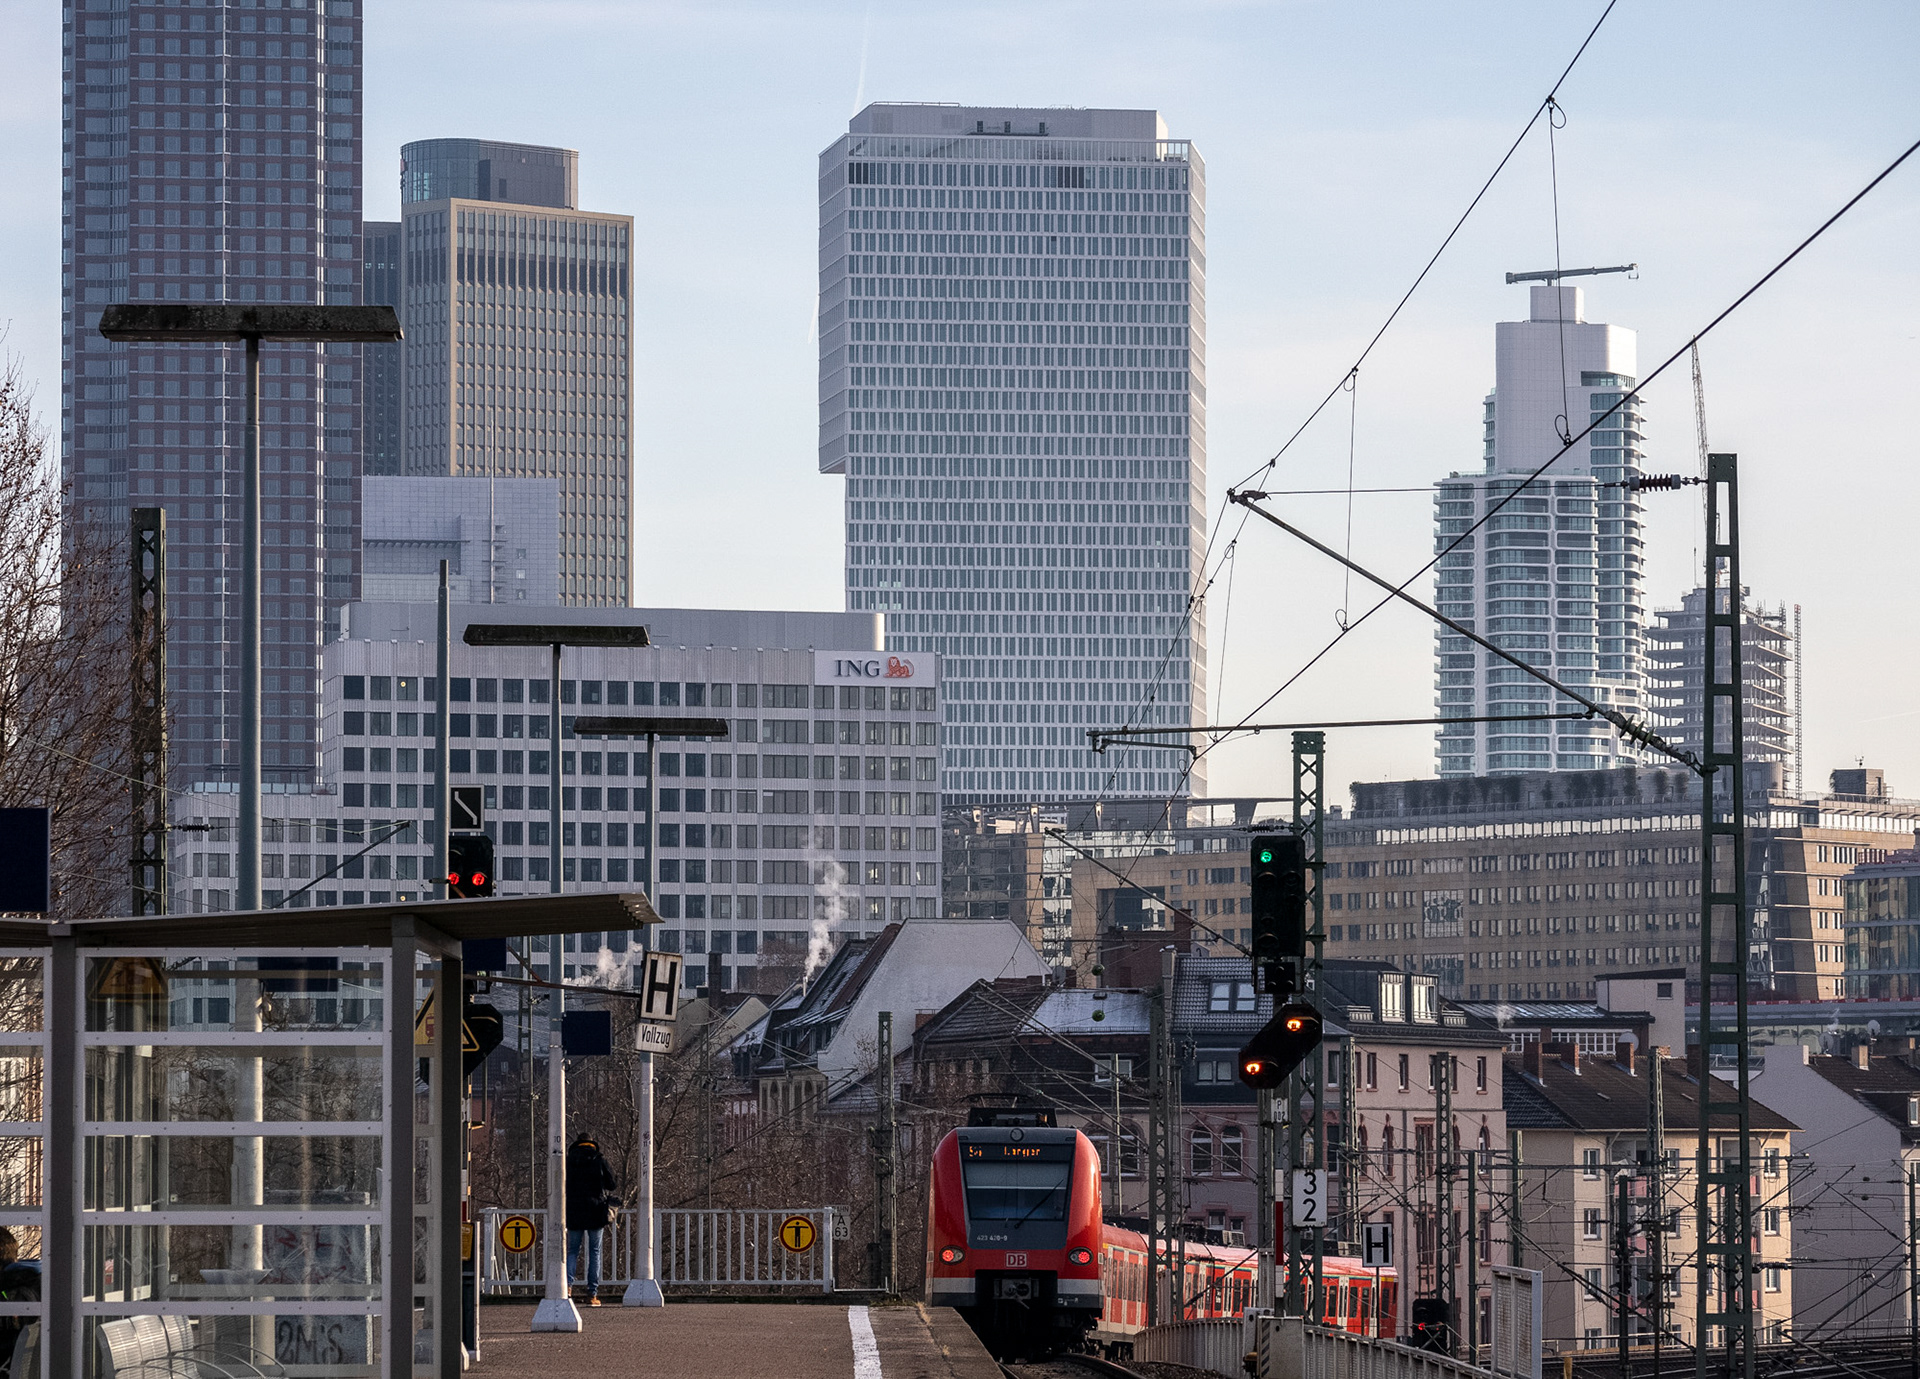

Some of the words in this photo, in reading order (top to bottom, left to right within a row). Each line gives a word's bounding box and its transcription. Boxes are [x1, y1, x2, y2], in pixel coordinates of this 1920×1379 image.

[834, 659, 881, 678] ING
[645, 959, 678, 1016] H
[641, 1025, 671, 1048] Vollzug
[1303, 1172, 1317, 1195] 3
[837, 1215, 846, 1226] A
[1302, 1198, 1317, 1222] 2
[834, 1226, 849, 1238] 63
[1365, 1226, 1390, 1263] H
[1007, 1254, 1027, 1266] DB
